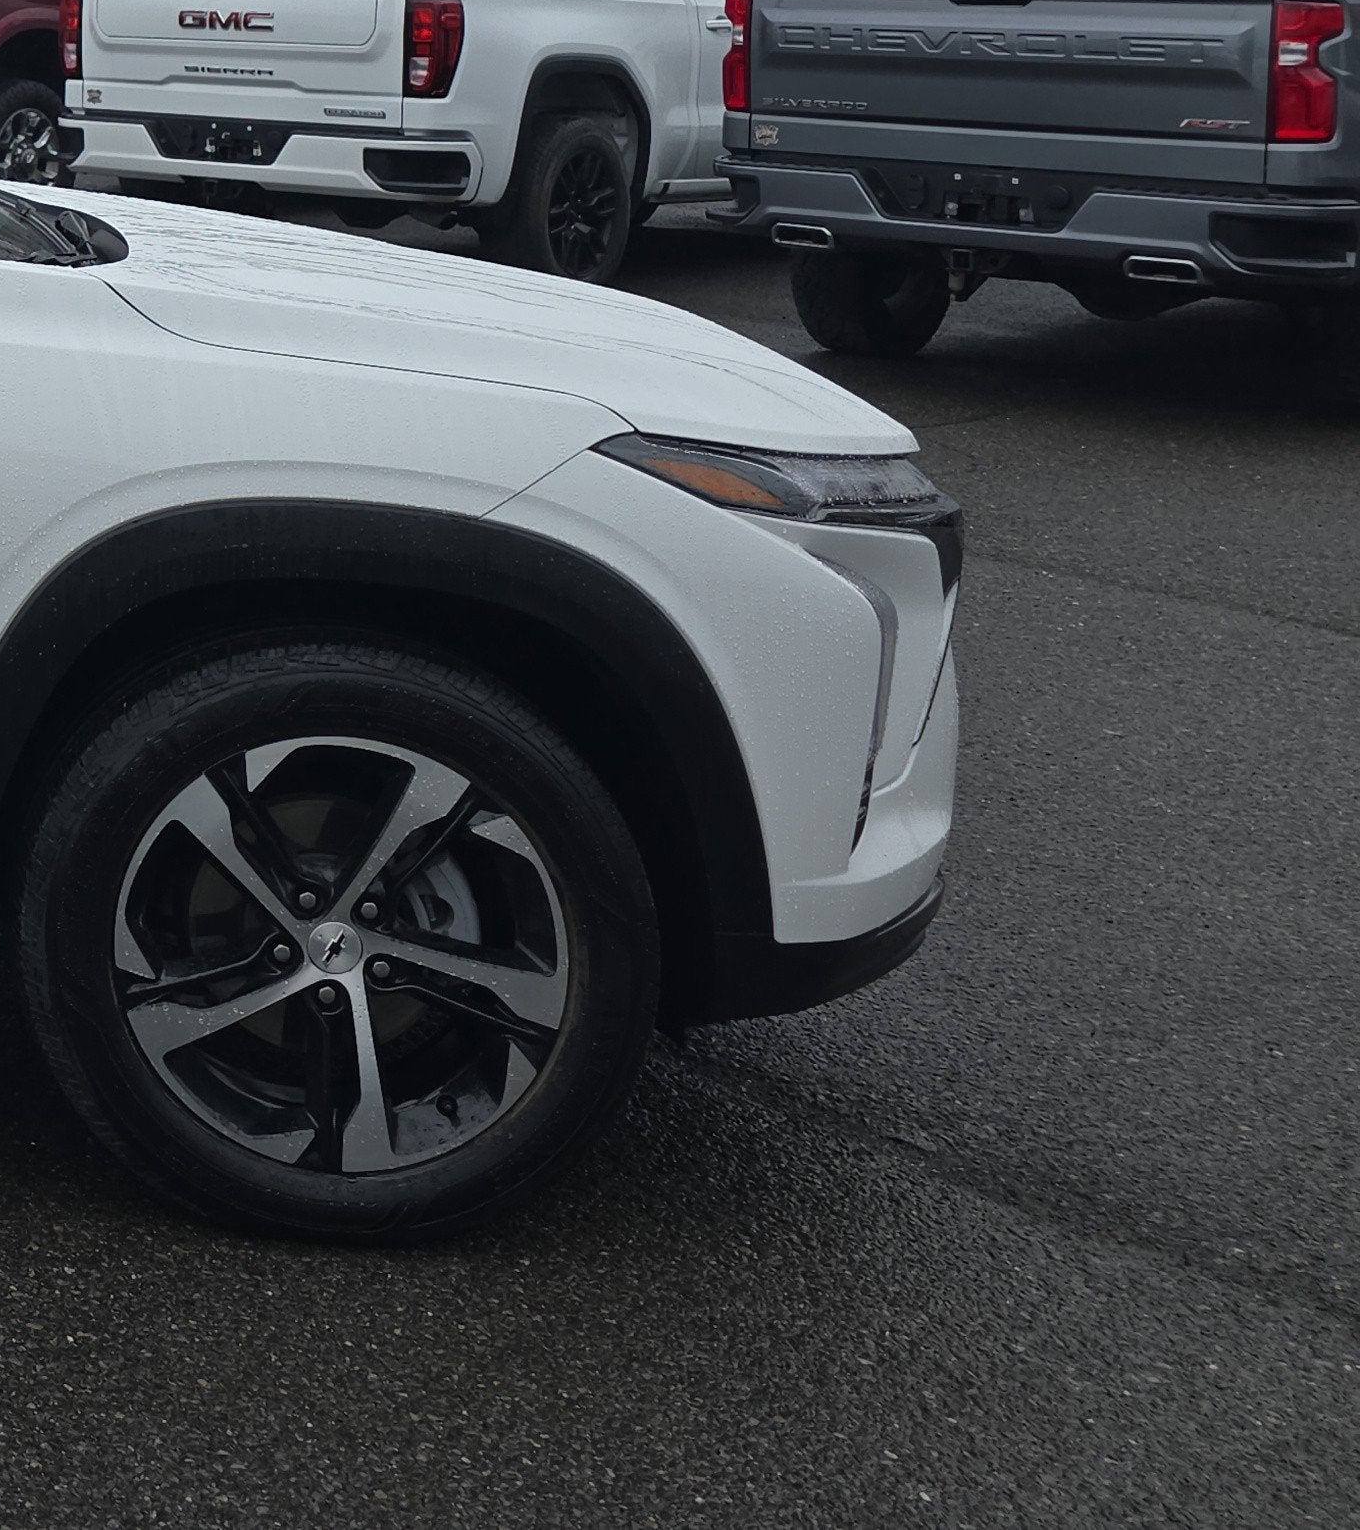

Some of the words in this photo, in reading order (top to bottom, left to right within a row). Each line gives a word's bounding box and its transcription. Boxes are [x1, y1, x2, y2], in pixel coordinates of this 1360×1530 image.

[178, 10, 274, 32] GMC
[778, 26, 1225, 63] CHEVROLET
[184, 65, 274, 76] SIERRA
